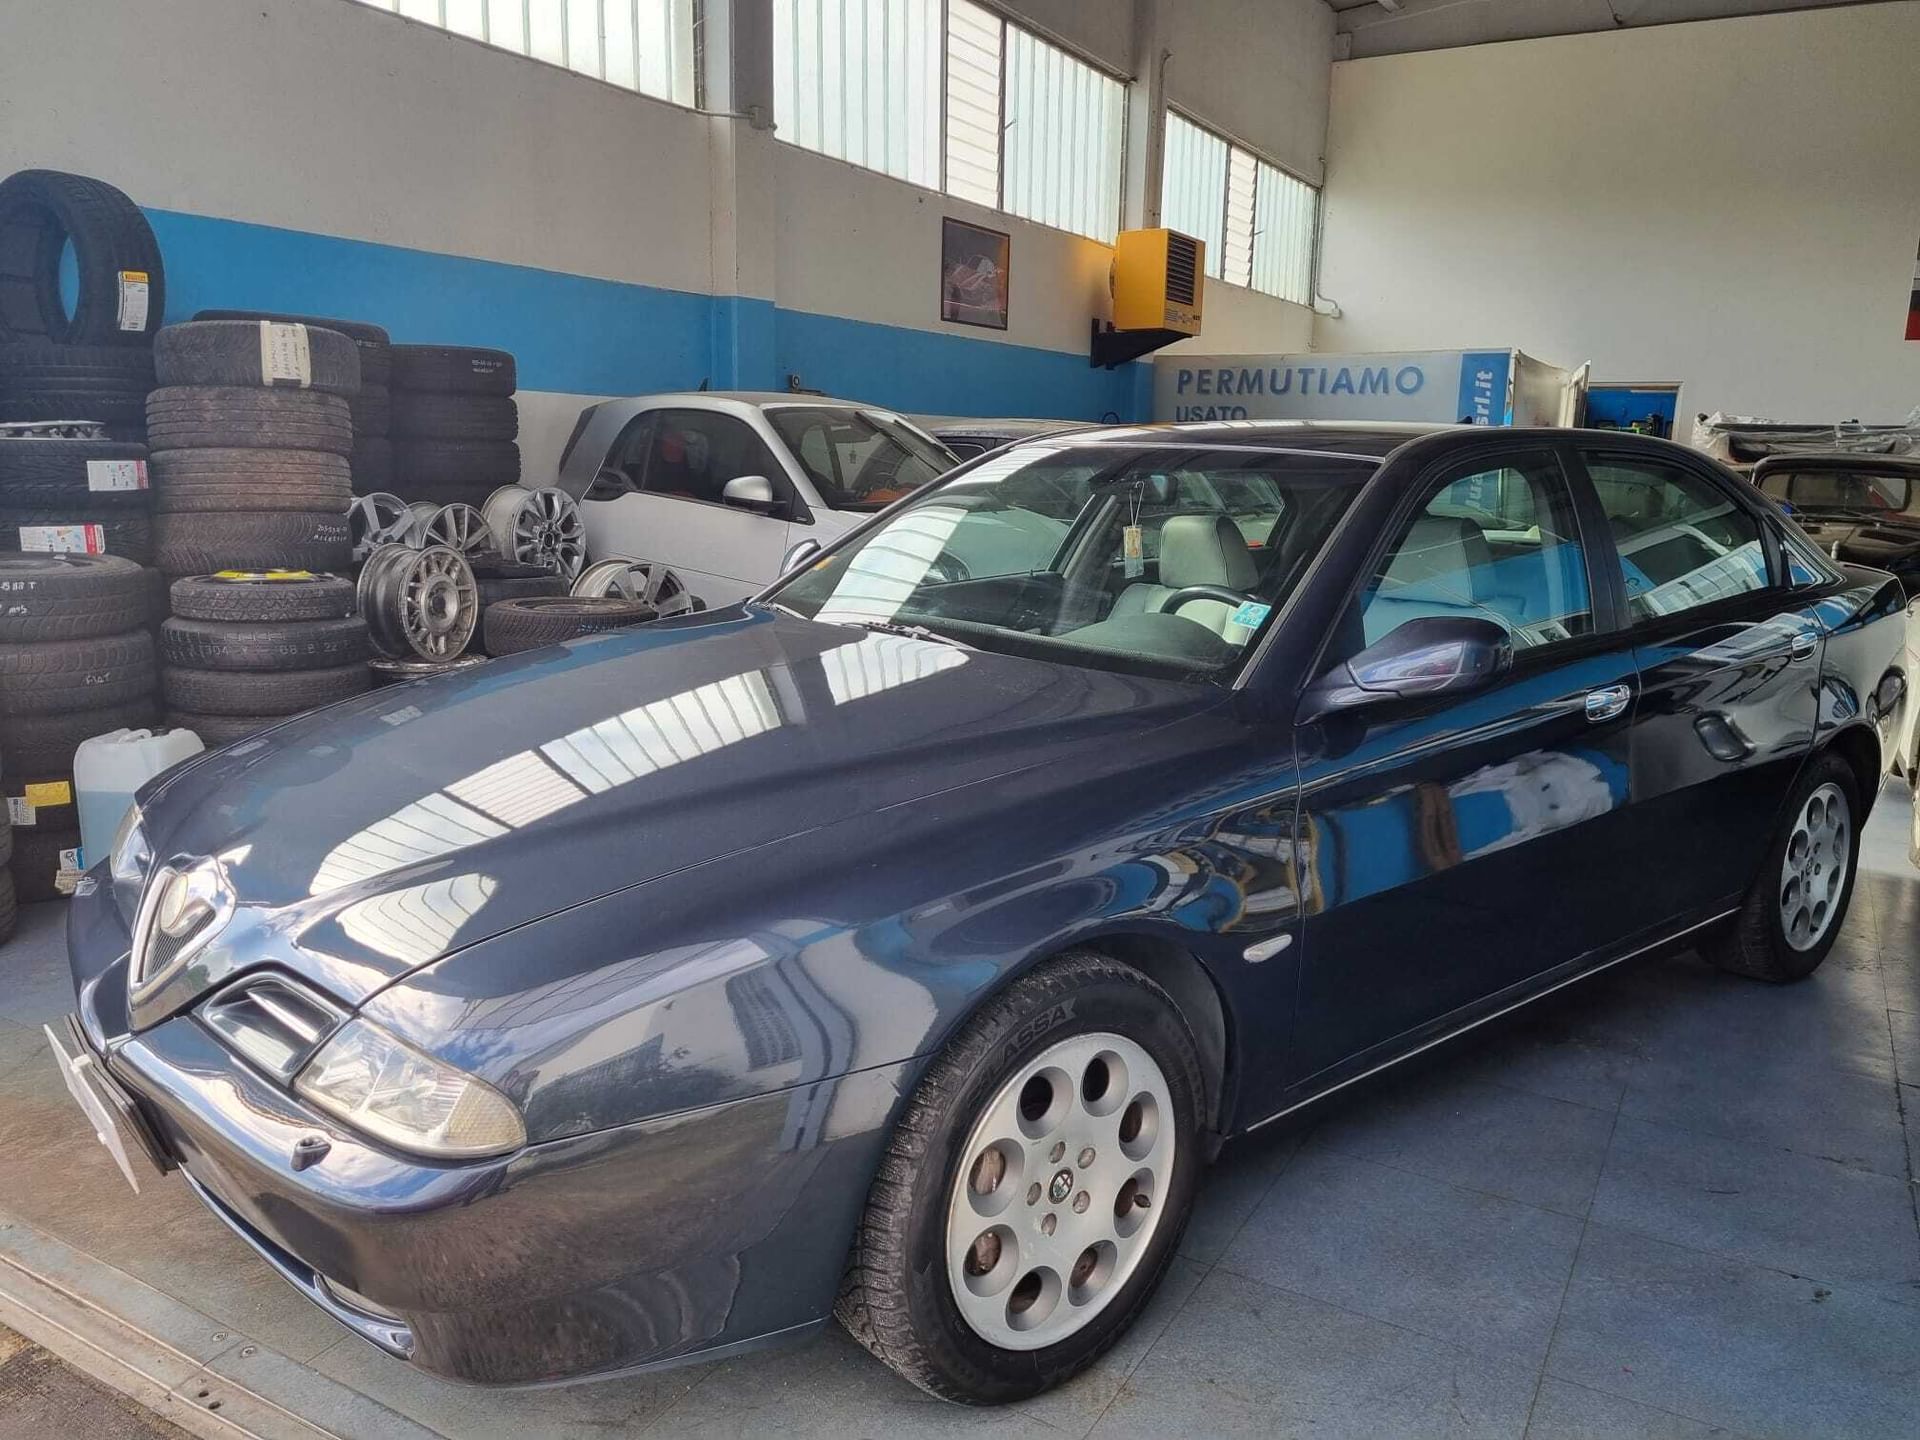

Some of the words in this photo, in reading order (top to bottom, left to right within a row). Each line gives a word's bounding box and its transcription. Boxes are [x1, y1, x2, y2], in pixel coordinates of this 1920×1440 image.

[1177, 366, 1425, 396] PERMUTIAMO
[1474, 370, 1493, 425] srl.it
[1175, 405, 1248, 422] USATO
